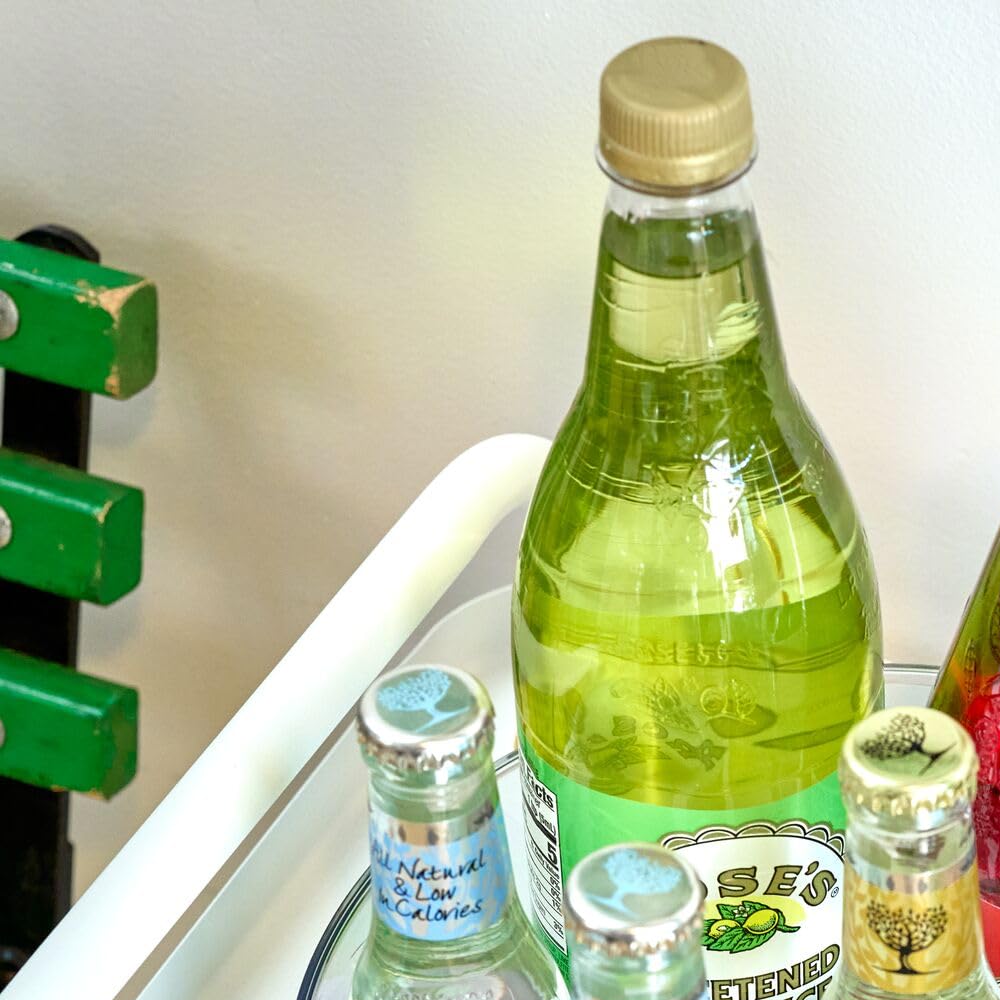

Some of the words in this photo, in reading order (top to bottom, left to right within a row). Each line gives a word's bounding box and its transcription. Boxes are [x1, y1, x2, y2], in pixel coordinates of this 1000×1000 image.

[398, 849, 487, 881] Natural
[393, 877, 411, 898] &
[416, 882, 456, 902] Low
[702, 861, 838, 907] SE'S
[395, 899, 483, 922] Calories
